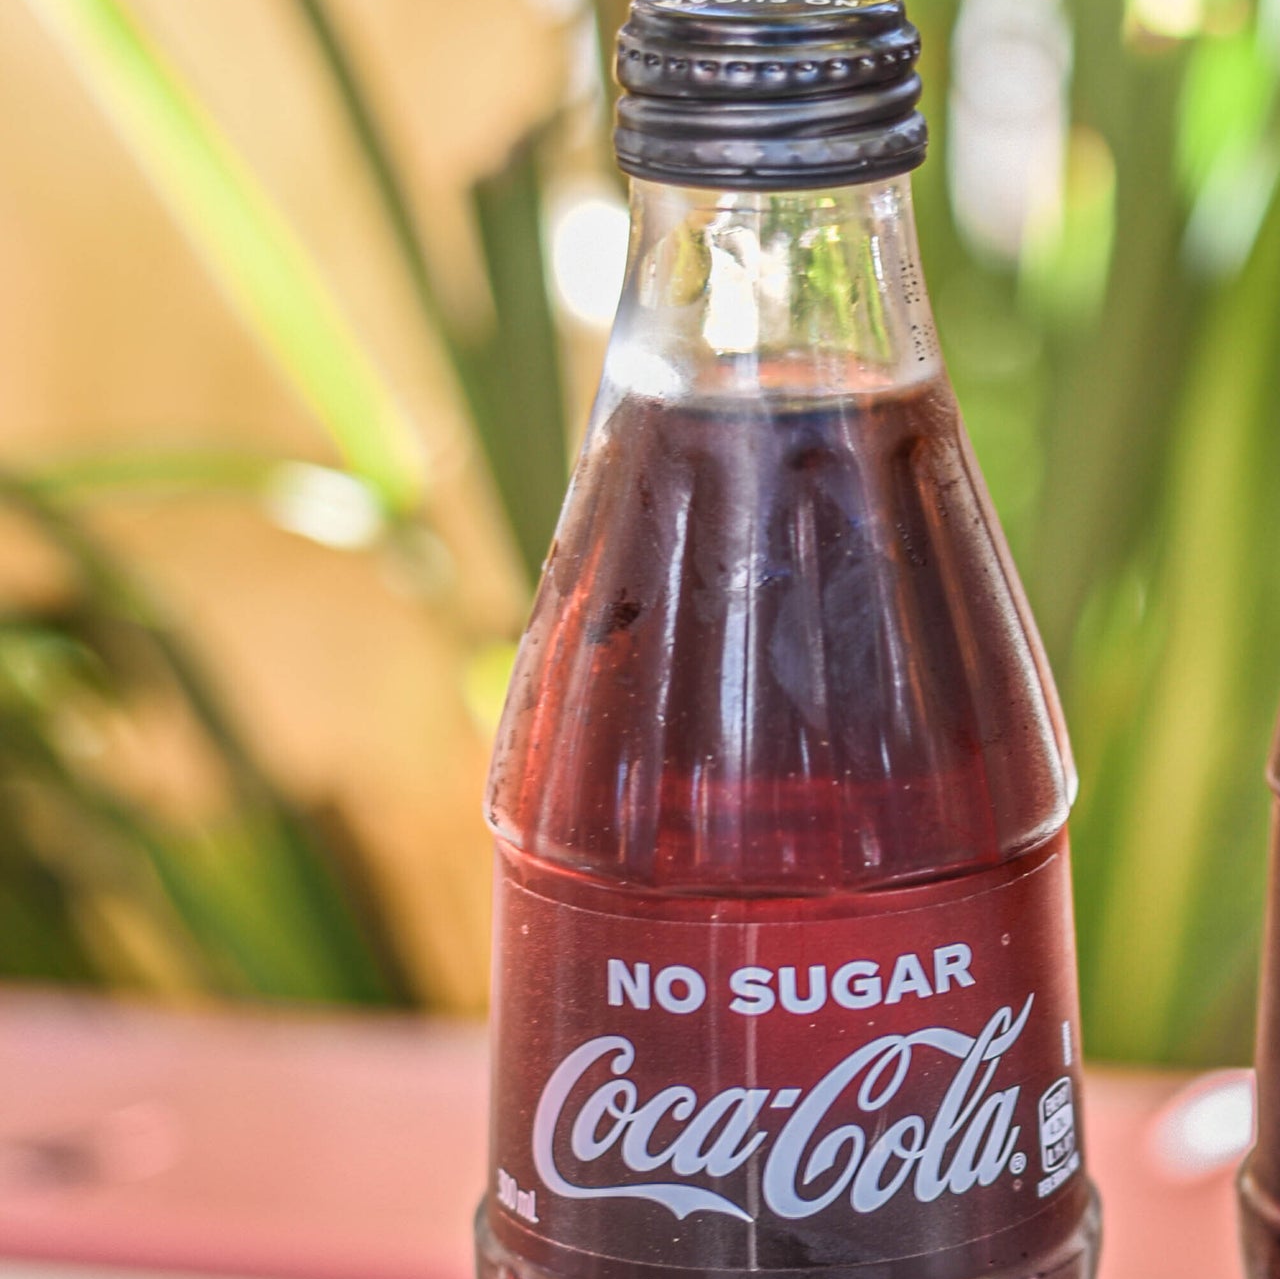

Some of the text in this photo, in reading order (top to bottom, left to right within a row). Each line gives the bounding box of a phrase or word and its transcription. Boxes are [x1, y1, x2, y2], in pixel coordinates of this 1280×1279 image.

[606, 942, 977, 1016] NO SUGAR
[532, 992, 1036, 1223] Coca-Cola
